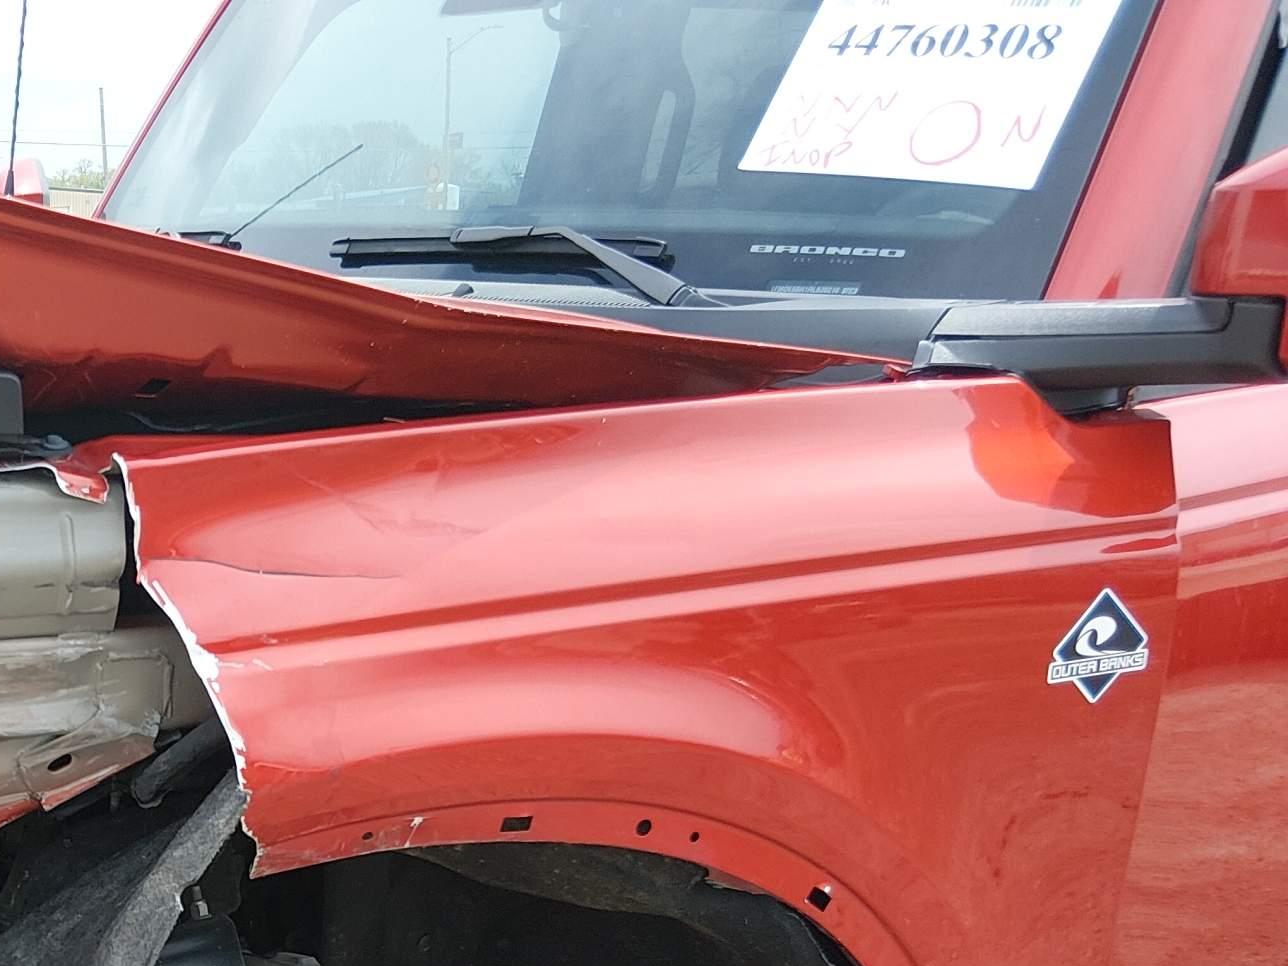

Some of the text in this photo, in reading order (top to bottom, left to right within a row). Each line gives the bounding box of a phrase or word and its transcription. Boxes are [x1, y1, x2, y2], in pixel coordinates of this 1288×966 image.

[828, 23, 1062, 60] 44760308
[750, 244, 906, 258] BRONCO
[1052, 653, 1144, 679] OUTER BANKS
